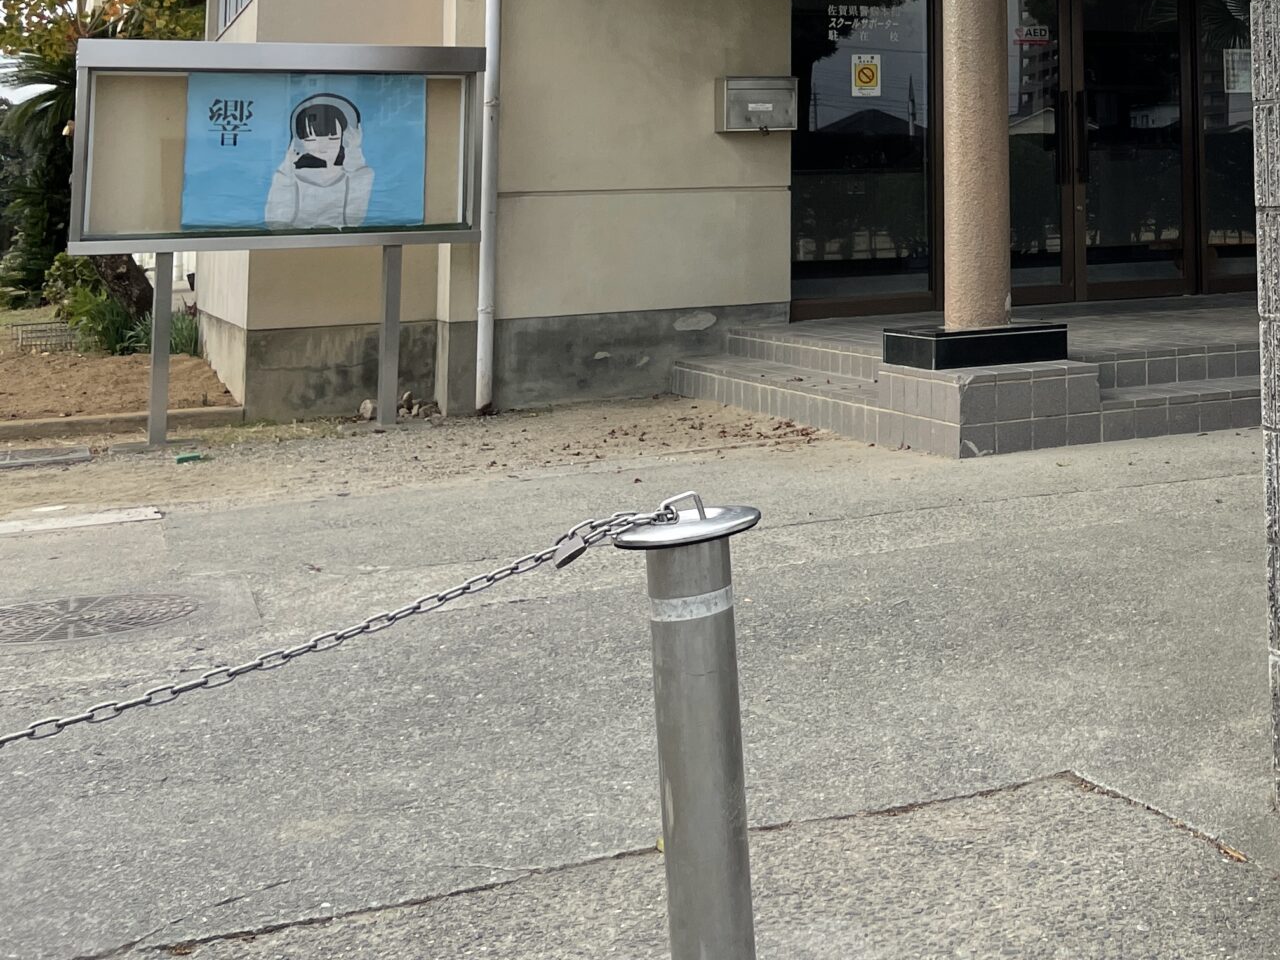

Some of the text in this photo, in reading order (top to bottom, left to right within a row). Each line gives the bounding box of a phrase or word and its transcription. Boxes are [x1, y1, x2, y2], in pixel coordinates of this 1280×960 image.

[828, 17, 900, 30] スクールサポーター
[1025, 28, 1047, 37] AED
[208, 98, 254, 147] 響
